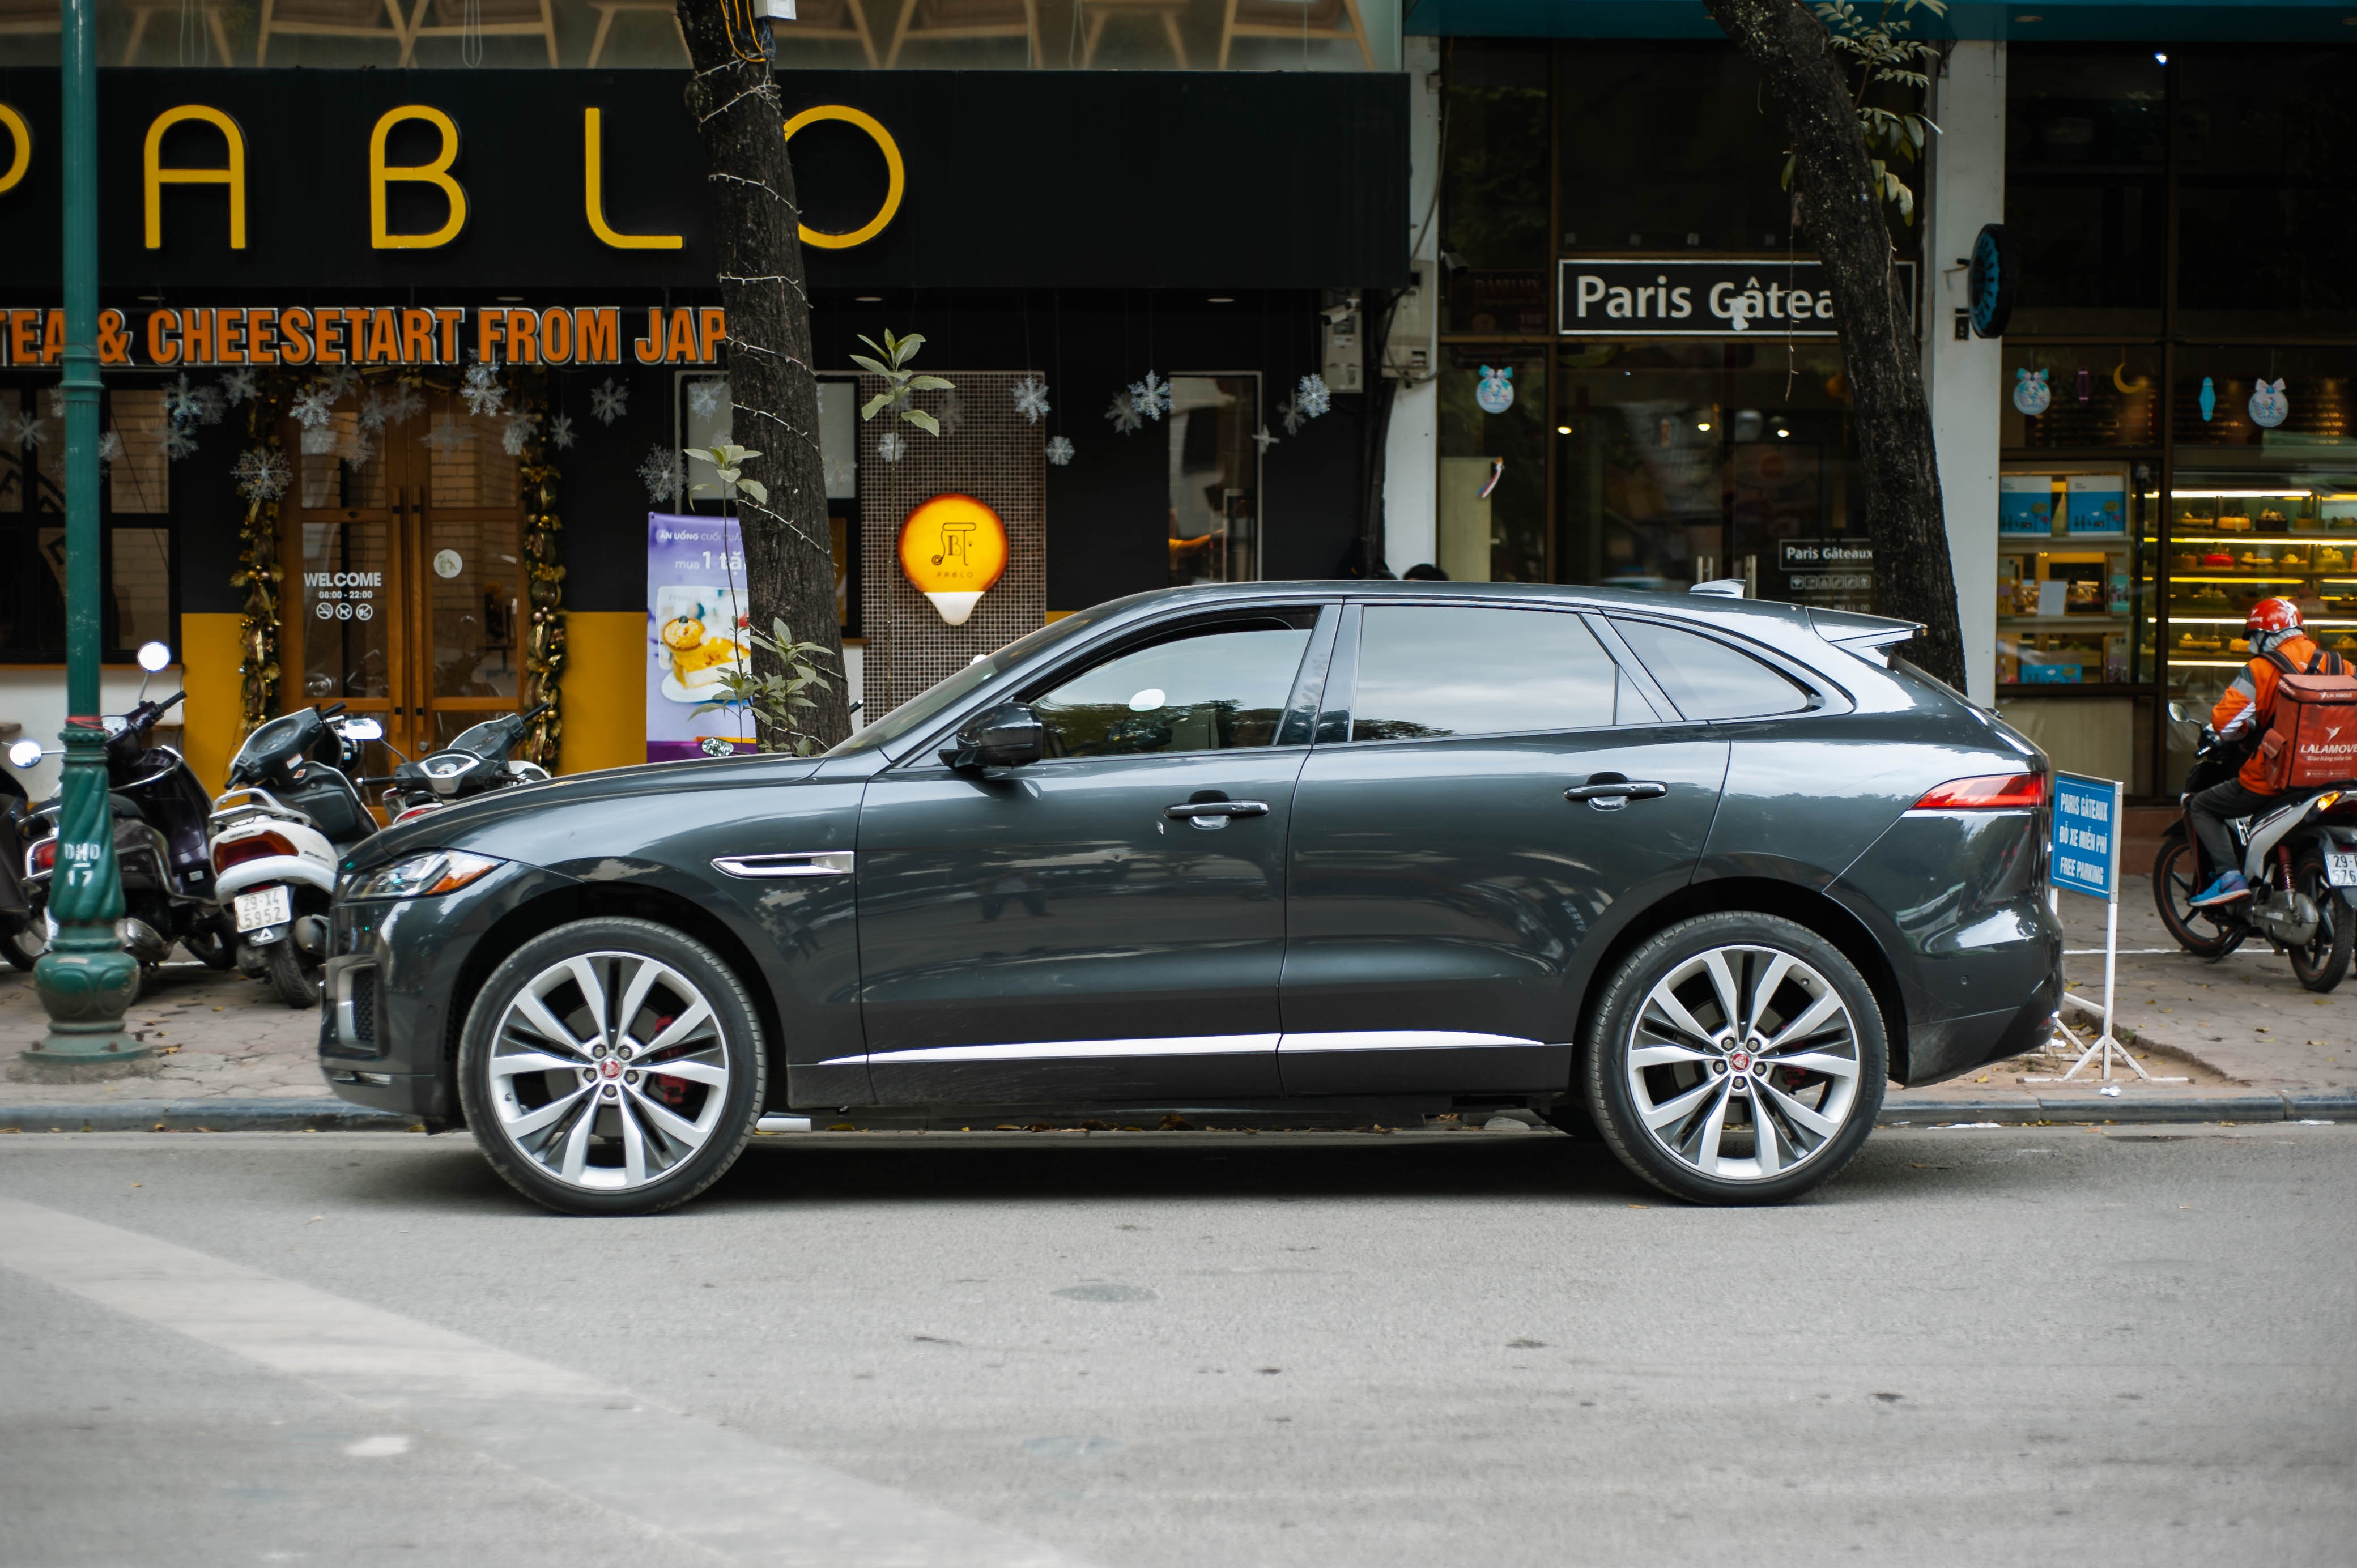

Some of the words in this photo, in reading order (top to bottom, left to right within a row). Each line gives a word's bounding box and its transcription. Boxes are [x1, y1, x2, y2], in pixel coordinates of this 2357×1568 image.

[1577, 275, 1692, 318] Paris
[0, 309, 65, 365] EA
[97, 309, 134, 365] &
[148, 308, 465, 365] CHEESETART
[478, 306, 621, 365] FROM
[675, 560, 700, 569] mua
[702, 551, 711, 570] 1
[1786, 546, 1819, 560] Paris
[1822, 546, 1873, 560] Gâteaux
[303, 572, 381, 587] WELCOME
[318, 591, 342, 599] 08:00
[349, 591, 373, 599] 22:00
[2060, 792, 2079, 816] PARIS
[2081, 794, 2108, 822] GÂTEAUX
[2069, 828, 2078, 847] XE
[68, 870, 93, 887] 17
[2060, 856, 2076, 877] FREE
[2076, 860, 2104, 885] PARKING
[244, 906, 282, 928] 5952
